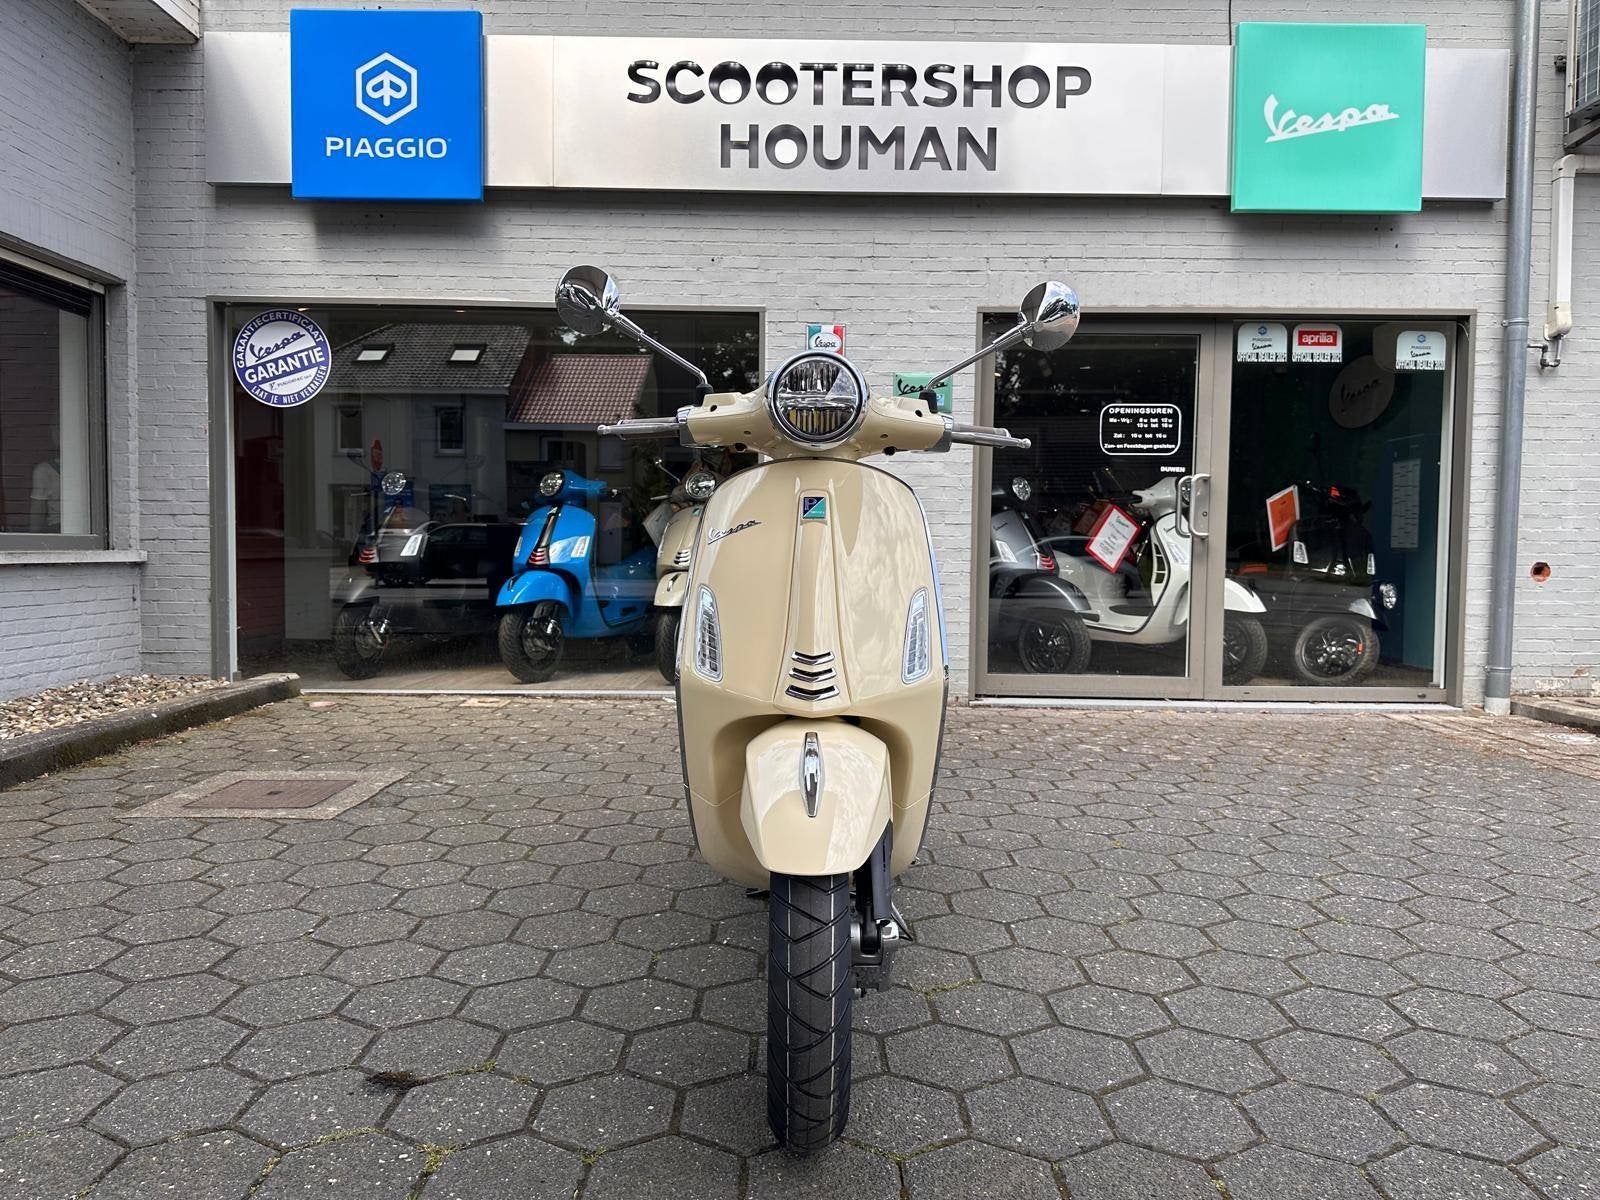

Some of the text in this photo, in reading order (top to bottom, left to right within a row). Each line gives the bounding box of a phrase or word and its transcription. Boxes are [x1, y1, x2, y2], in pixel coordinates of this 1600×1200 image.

[627, 60, 1092, 109] SCOOTERSHOP
[1264, 93, 1400, 143] Vespa
[325, 136, 447, 159] PIAGGIO
[720, 123, 997, 171] HOUMAN
[236, 311, 323, 368] GARANTIECERTIFICAAT
[249, 332, 306, 363] Vespa
[814, 335, 837, 348] Vespa
[1302, 332, 1333, 345] aprilia
[244, 347, 325, 384] GARANTIE
[1237, 352, 1257, 362] OFFICIAL
[1258, 352, 1276, 362] DEALER
[1292, 352, 1312, 362] OFFICIAL
[1313, 352, 1331, 362] DEALER
[1395, 360, 1415, 370] OFFICIAL
[251, 385, 267, 399] LAAT
[270, 395, 279, 404] JE
[282, 395, 299, 404] NIET
[300, 365, 327, 398] VERRASSEN
[897, 378, 949, 396] Vesa
[708, 520, 762, 545] Vespa
